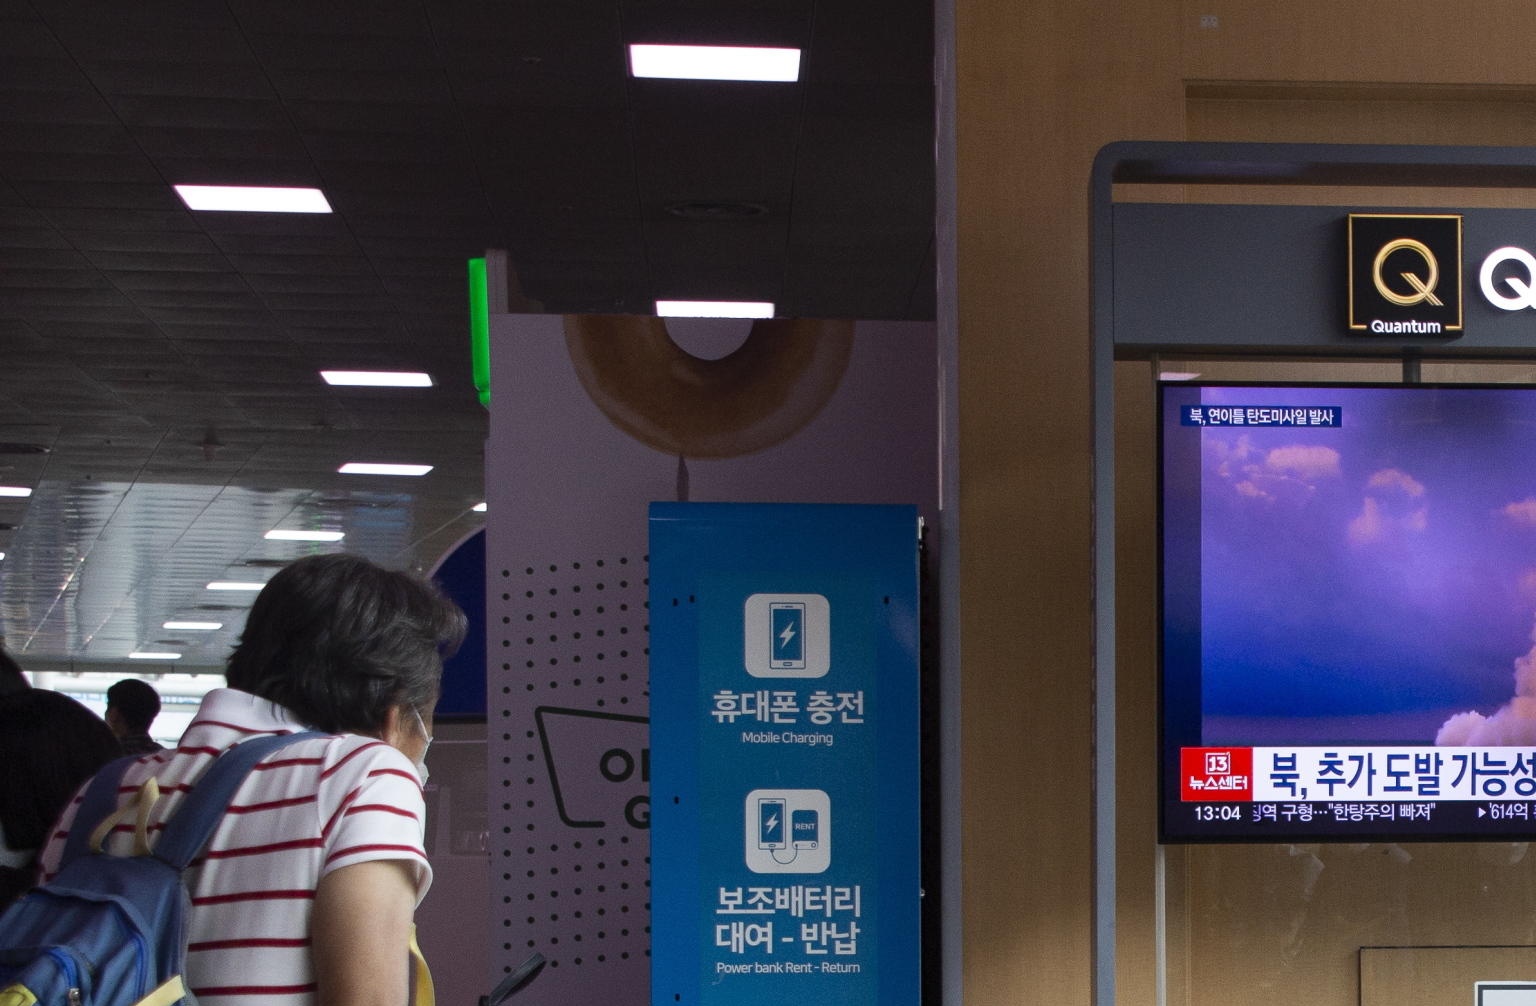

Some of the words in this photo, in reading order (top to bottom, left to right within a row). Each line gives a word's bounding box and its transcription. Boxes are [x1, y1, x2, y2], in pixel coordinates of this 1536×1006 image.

[1372, 238, 1445, 307] Q
[1371, 319, 1442, 334] Quantum
[1189, 408, 1207, 426] 북,
[1247, 408, 1307, 426] 탄도미사일
[1309, 408, 1335, 426] 발사
[711, 689, 800, 724] 휴대폰
[806, 689, 865, 726] 충전
[742, 732, 781, 744] Mobile
[782, 732, 834, 747] Charging
[1208, 756, 1228, 771] 13
[1188, 774, 1248, 791] 뉴스센터
[1269, 751, 1309, 800] 북,
[1316, 751, 1378, 797] 추가
[1382, 751, 1444, 797] 도발
[1194, 805, 1243, 822] 13:04
[795, 823, 815, 831] RENT
[716, 885, 861, 918] 보조배터리
[716, 921, 773, 954] 대여
[801, 921, 861, 955] 반납
[717, 962, 753, 974] Power
[754, 962, 783, 974] bank
[785, 962, 812, 974] Rent
[821, 962, 861, 974] Return
